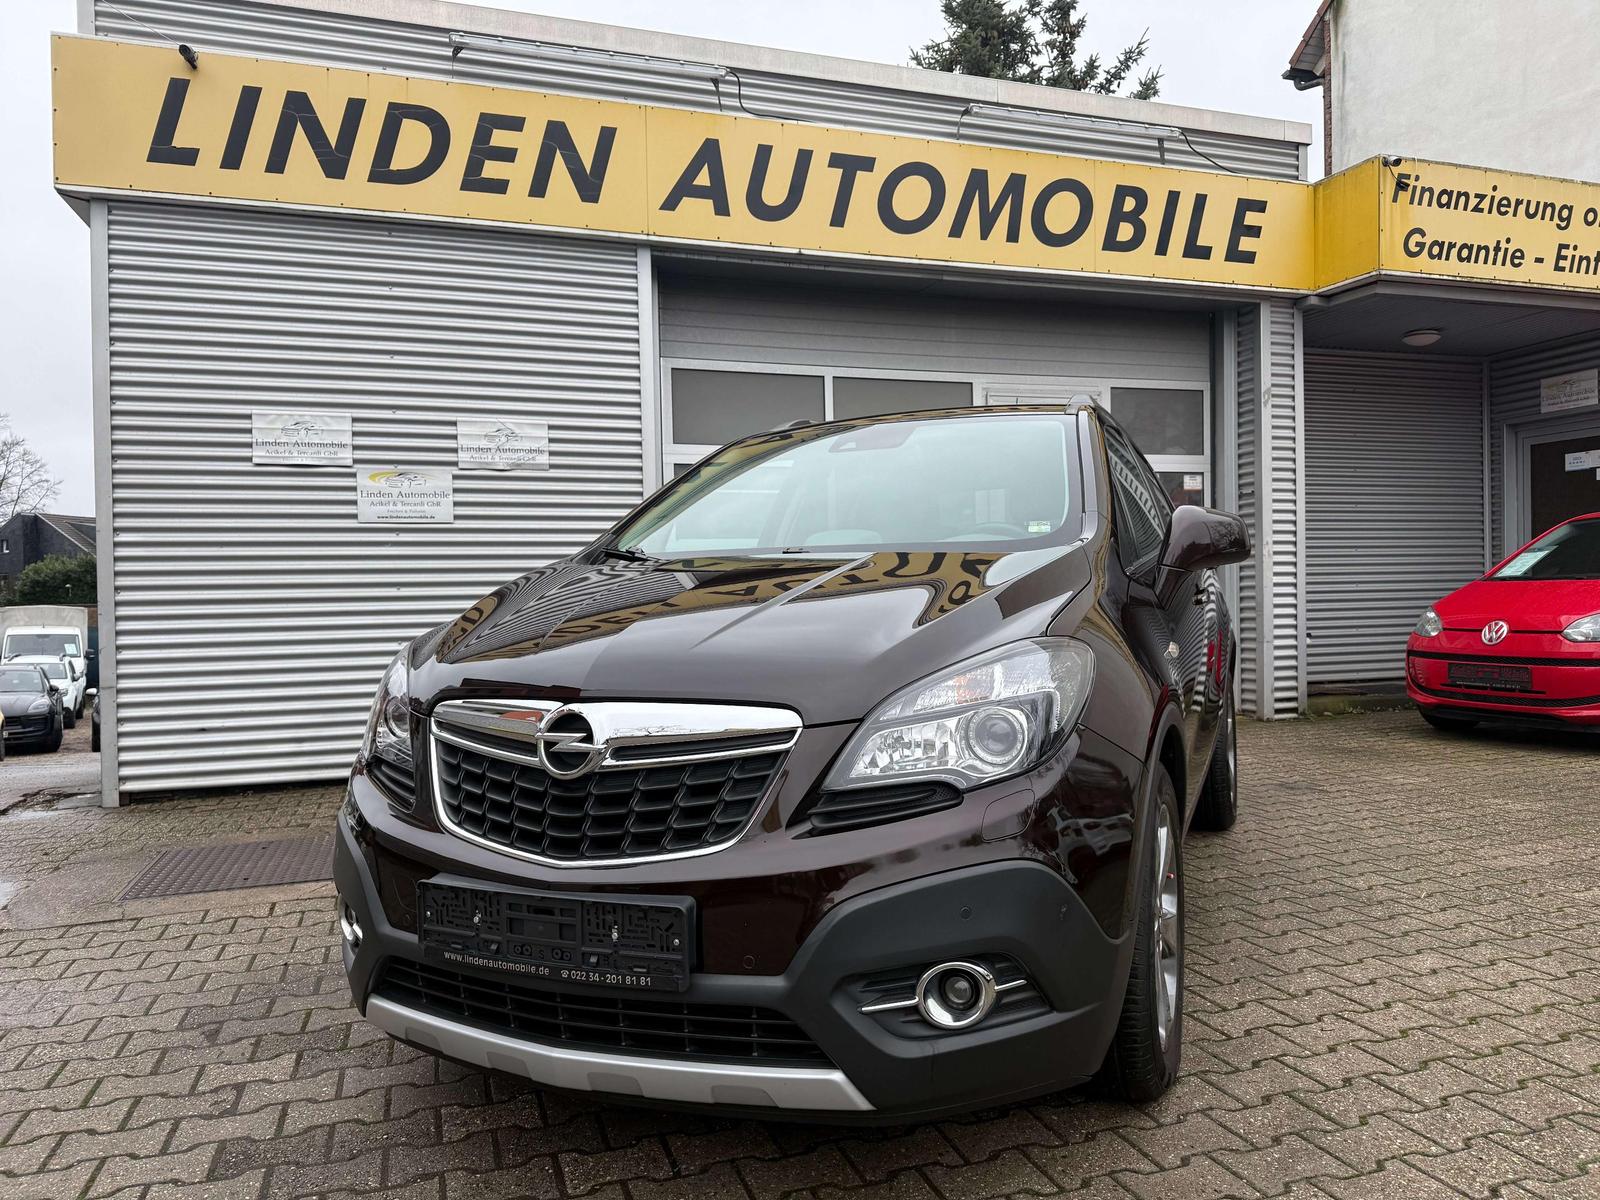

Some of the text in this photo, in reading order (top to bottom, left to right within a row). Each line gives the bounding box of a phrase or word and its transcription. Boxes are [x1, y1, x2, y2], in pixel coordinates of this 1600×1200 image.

[146, 78, 1267, 265] LINDEN AUTOMOBILE
[1392, 172, 1574, 231] Finanzierung
[1403, 227, 1525, 268] Garantie
[255, 438, 349, 449] Linden Automobile
[460, 444, 545, 455] Linden Automobile
[360, 490, 451, 499] Linden Automobile
[443, 950, 550, 976] www.lindenautomobile.de
[571, 970, 587, 981] 022
[625, 975, 637, 985] 81
[639, 976, 652, 987] 81
